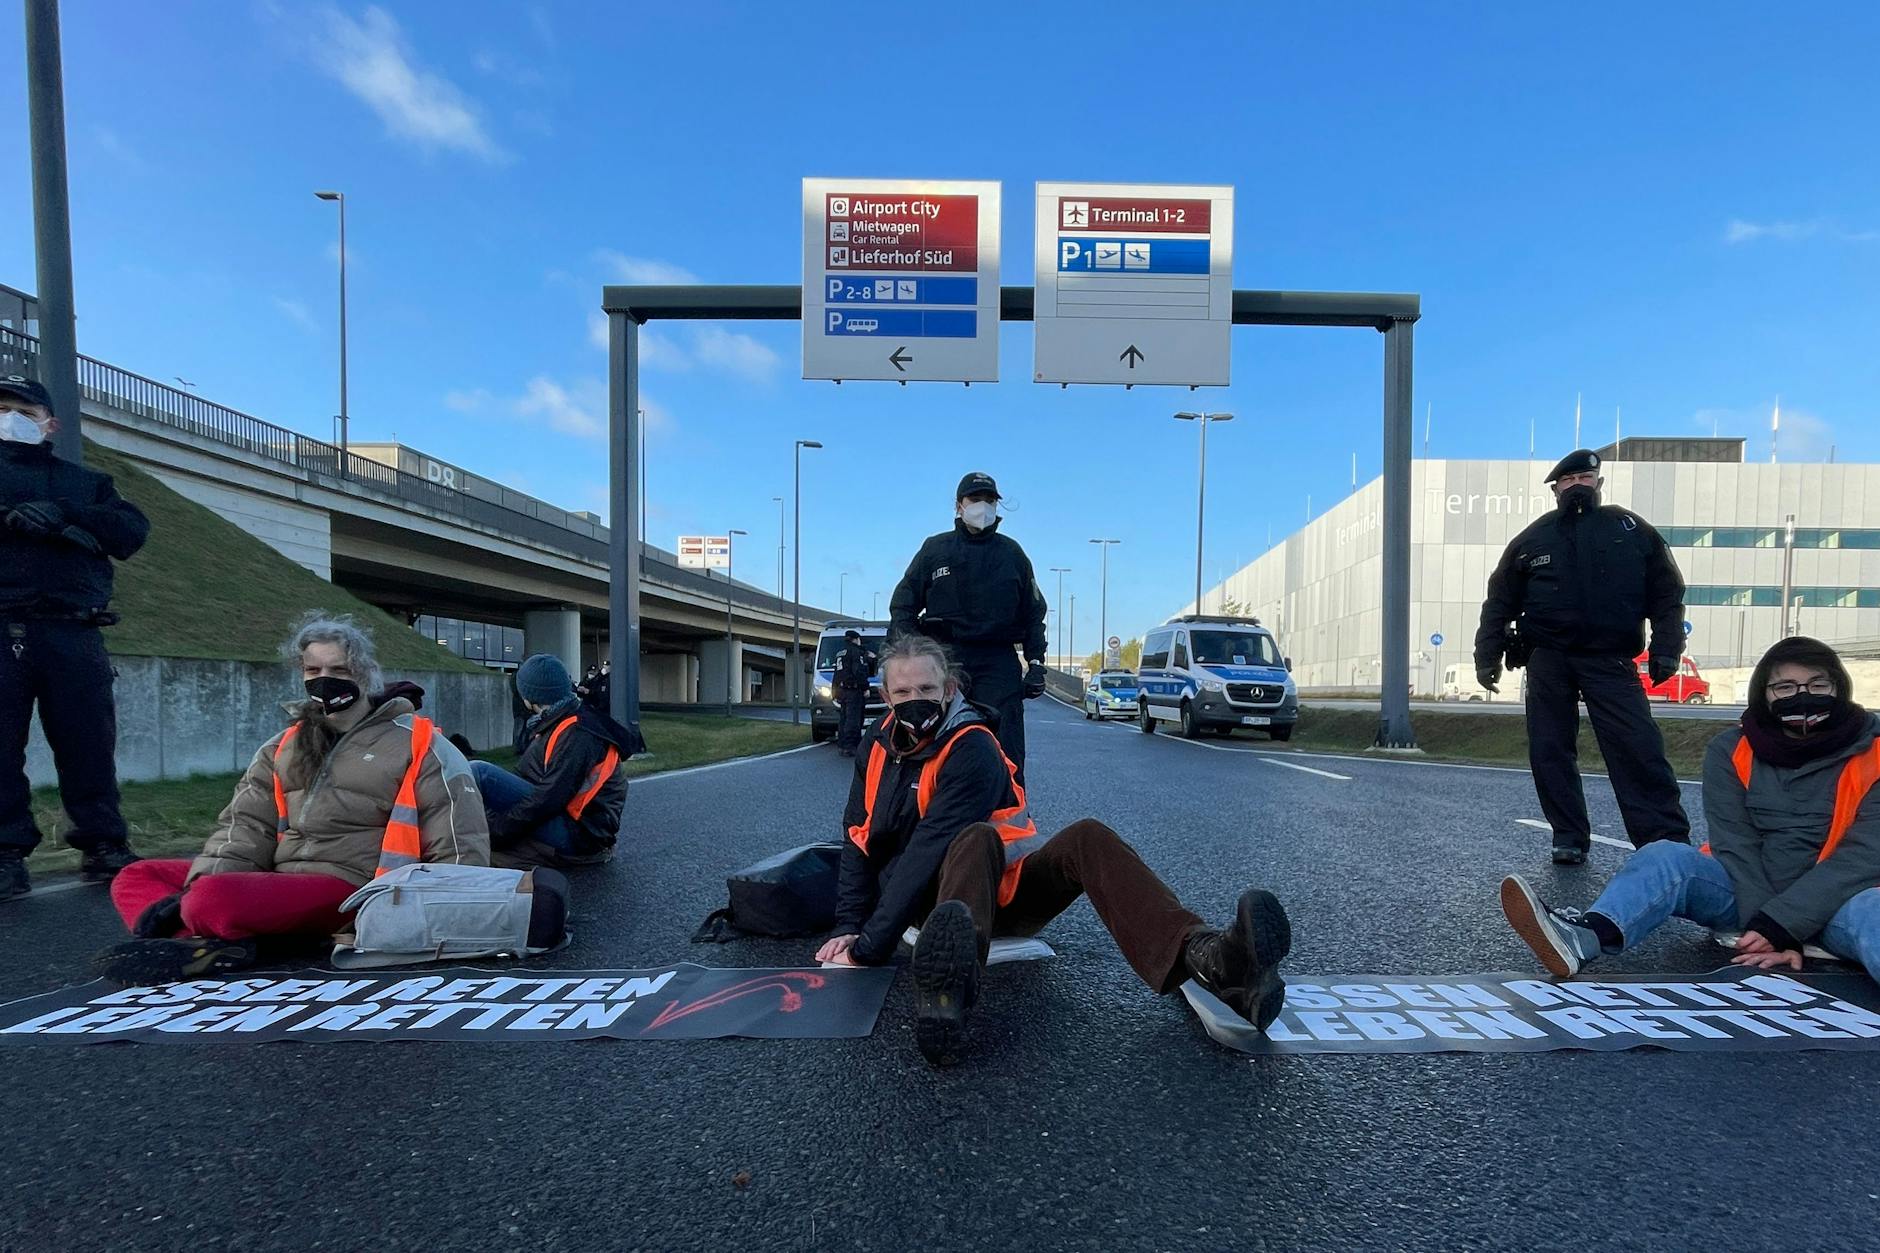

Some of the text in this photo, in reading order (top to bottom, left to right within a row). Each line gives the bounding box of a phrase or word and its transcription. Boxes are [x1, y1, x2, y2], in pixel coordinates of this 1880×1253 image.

[852, 200, 941, 219] Airport City
[1092, 207, 1186, 223] Terminal 1-2
[852, 220, 920, 236] Mietwagen
[852, 234, 900, 245] Car Rental
[851, 249, 953, 265] Lieferhof Süd
[1061, 241, 1092, 268] P 1
[829, 279, 872, 300] P 2-8
[828, 312, 843, 332] P
[1426, 487, 1546, 515] Termin
[87, 971, 678, 1004] ESSEN RETTEN
[1282, 983, 1512, 1009] SSEN
[0, 1001, 636, 1034] LEBEN RETTEN
[1264, 1000, 1880, 1042] LEBEN RETTEN
